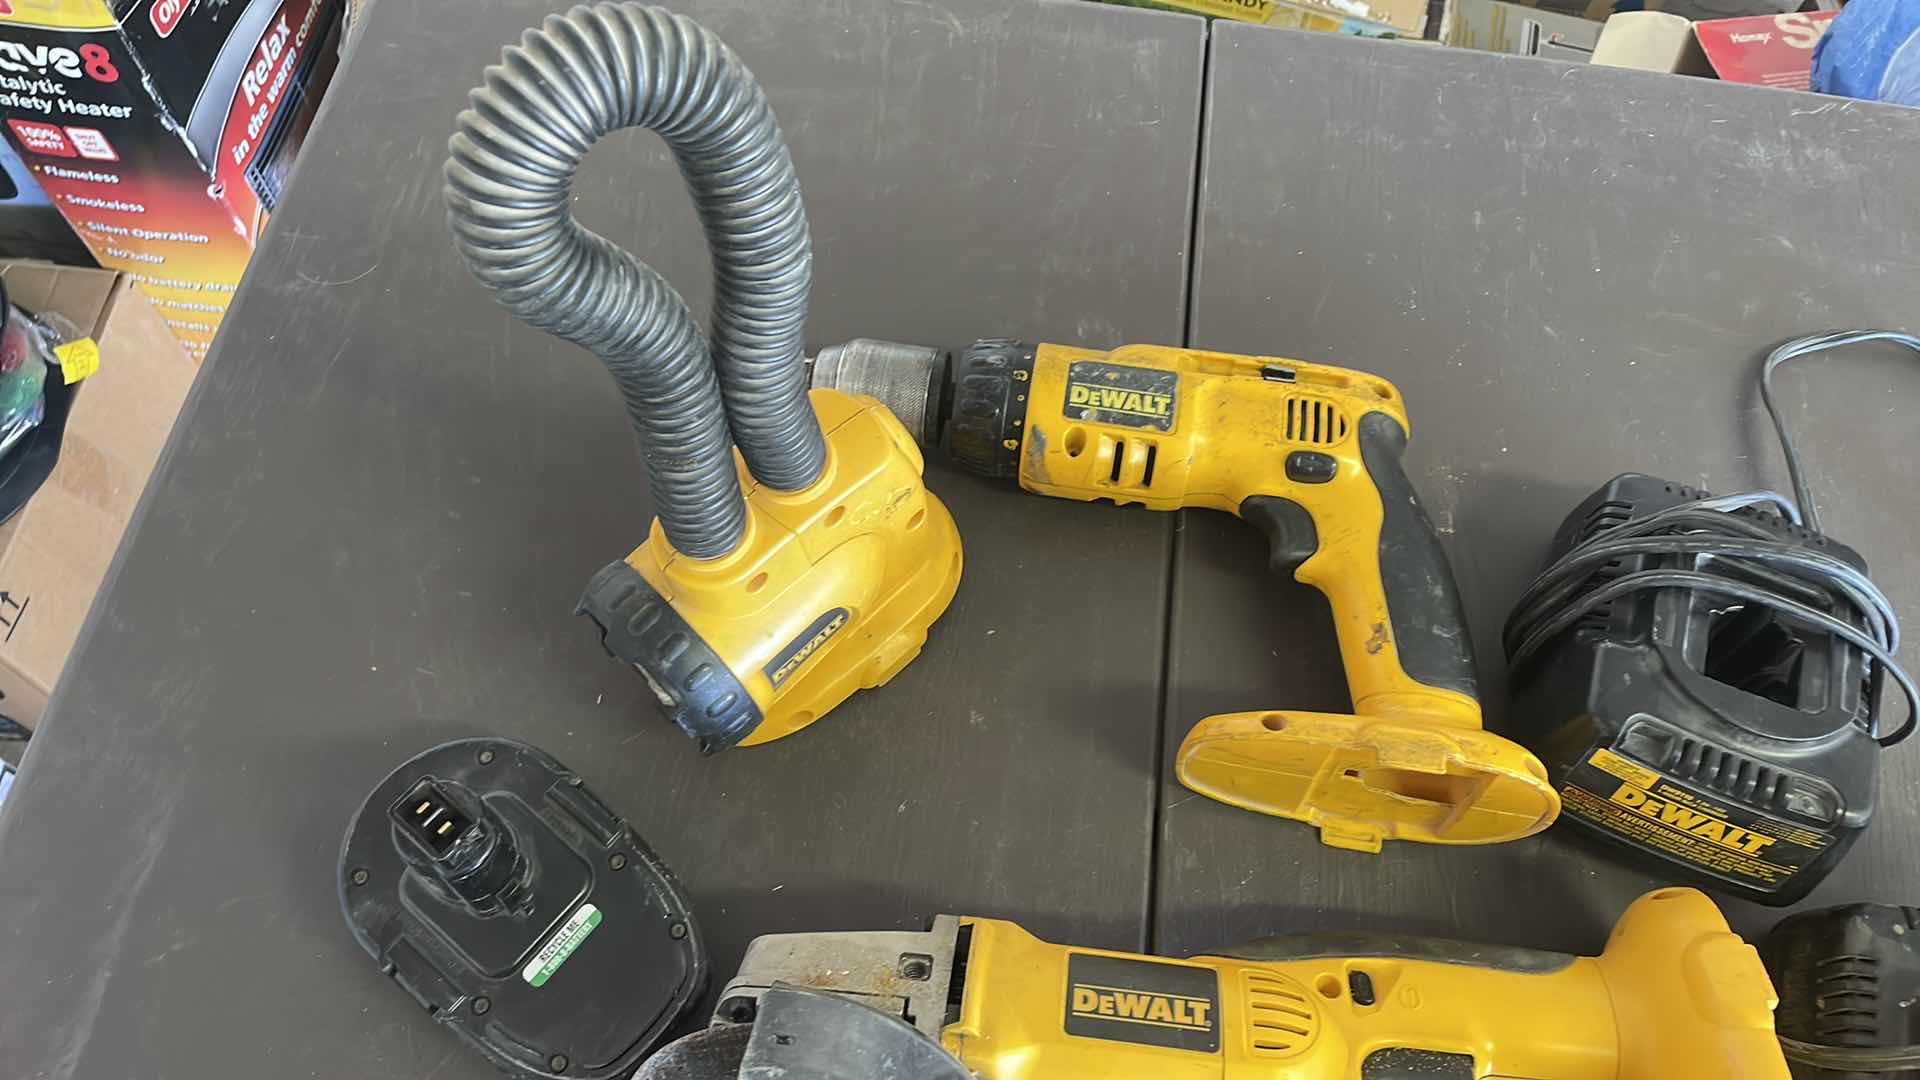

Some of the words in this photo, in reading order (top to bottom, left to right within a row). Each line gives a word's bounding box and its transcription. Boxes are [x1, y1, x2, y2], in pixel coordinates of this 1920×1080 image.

[241, 13, 291, 107] Relax
[57, 98, 133, 118] Heater
[232, 139, 250, 165] in
[248, 103, 269, 140] the
[267, 47, 297, 103] warm
[16, 125, 62, 141] 100%
[43, 165, 119, 184] Flameless
[66, 194, 145, 213] Smokeless
[87, 220, 129, 236] Silent
[131, 227, 209, 243] Operation
